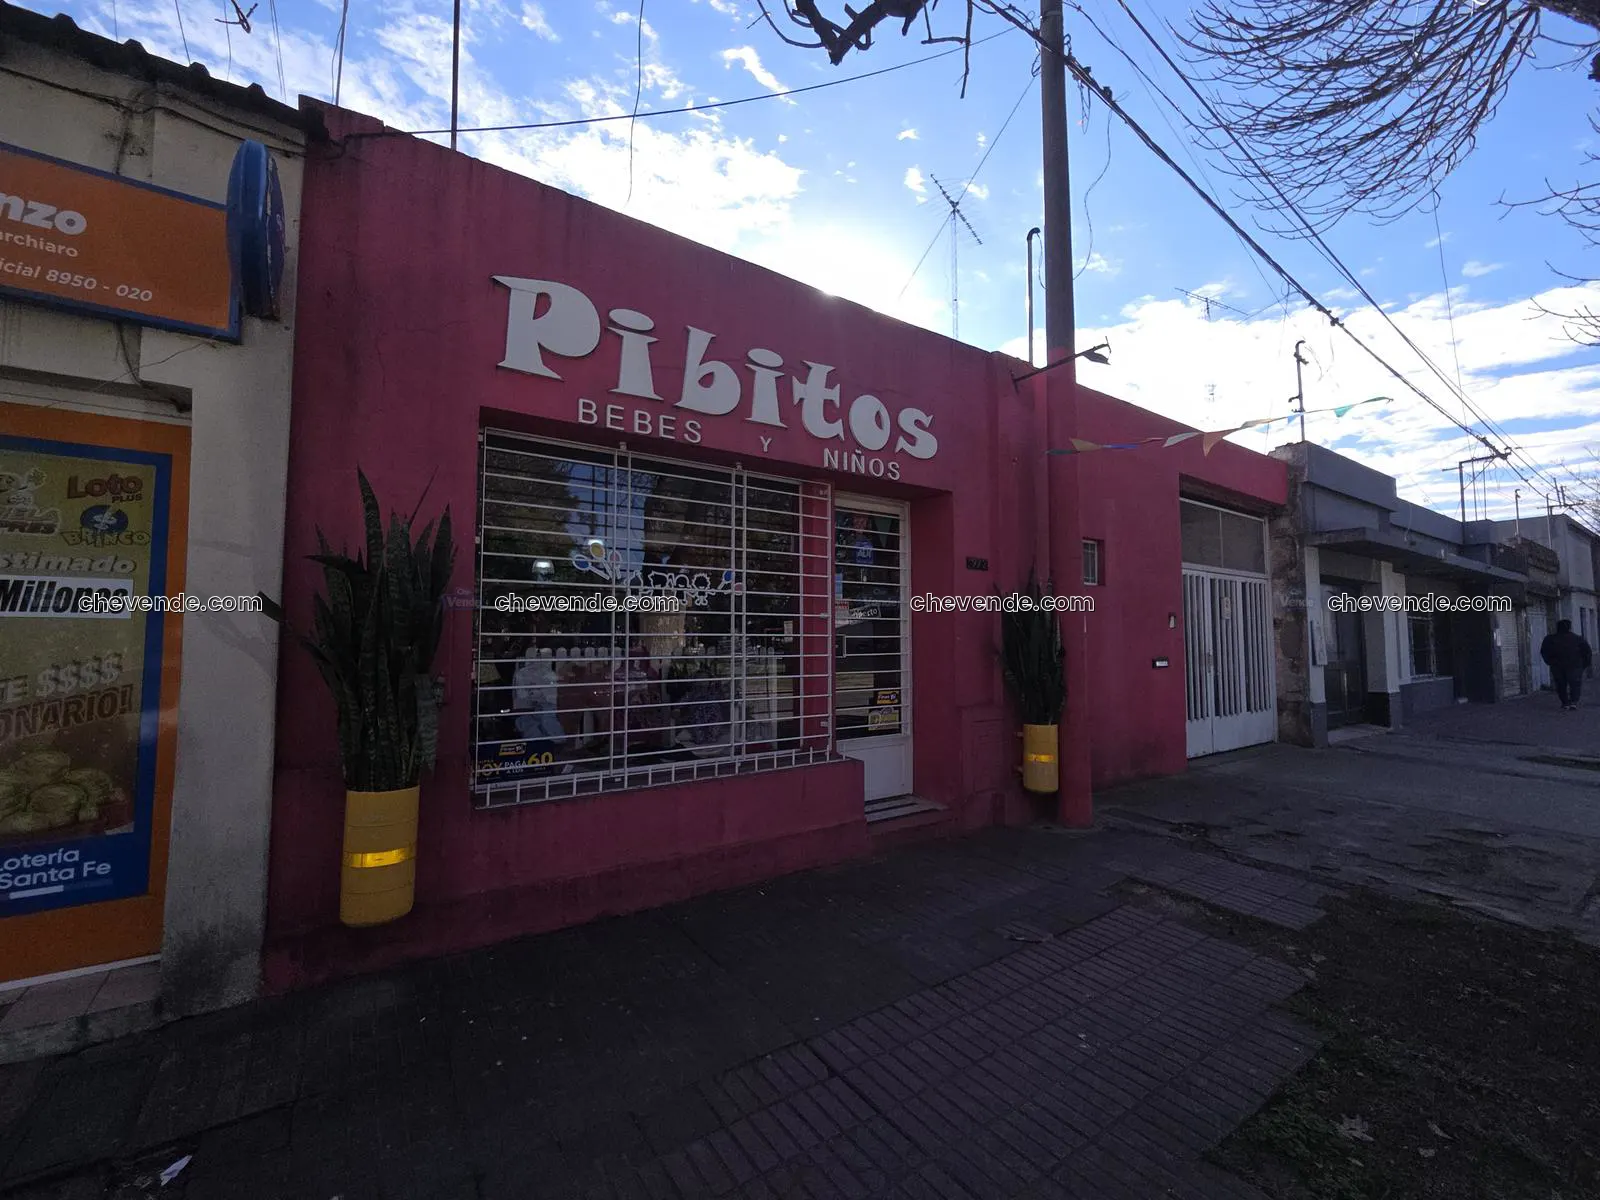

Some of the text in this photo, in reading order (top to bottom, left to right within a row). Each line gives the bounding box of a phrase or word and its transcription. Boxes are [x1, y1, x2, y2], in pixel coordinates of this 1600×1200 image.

[45, 269, 97, 290] 8950
[116, 284, 153, 301] 020
[490, 274, 938, 460] Pibitos
[577, 398, 900, 481] BEBES Y NIÑOS
[67, 474, 143, 499] Loto
[112, 493, 142, 503] PLUS
[0, 860, 112, 889] Santa Fe
